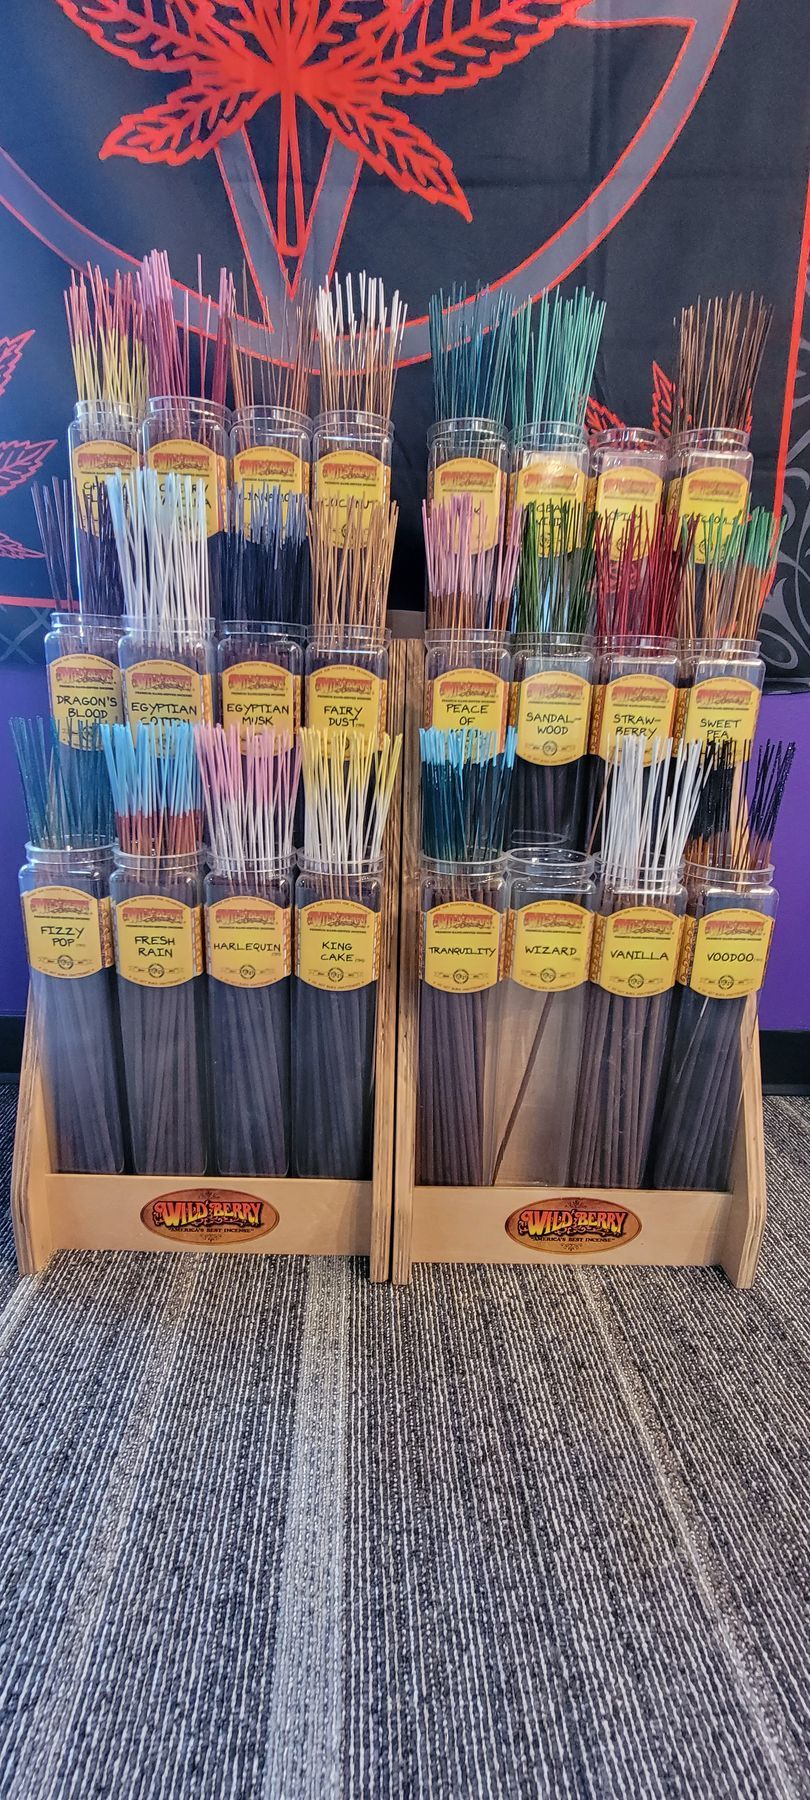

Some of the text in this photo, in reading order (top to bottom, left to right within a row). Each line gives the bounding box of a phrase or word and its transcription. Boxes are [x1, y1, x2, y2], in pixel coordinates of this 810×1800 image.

[56, 695, 117, 707] DRAGON'S
[68, 708, 108, 719] BLOOD
[131, 702, 197, 716] EGYPTIAN
[226, 703, 289, 715] EGYPTIAN
[324, 706, 363, 719] FAIRY
[446, 703, 489, 714] PEACE
[242, 716, 274, 726] MUSK
[329, 717, 358, 728] DUST
[459, 716, 475, 725] OF
[613, 714, 661, 725] STRAW-
[700, 718, 741, 729] SWEET
[537, 725, 569, 736] WOOD
[40, 926, 85, 939] FIZZY
[52, 938, 75, 947] POP
[134, 935, 176, 946] FRESH
[322, 941, 353, 951] KING
[138, 947, 173, 958] RAIN
[213, 942, 281, 953] HARLEQUIN
[429, 946, 497, 958] TRANQUILITY
[525, 945, 577, 956] WIZARD
[320, 953, 354, 962] CAKE
[610, 950, 669, 961] VANILLA
[707, 952, 754, 962] VOODOO
[153, 1200, 264, 1228] WILD BERRY
[518, 1209, 628, 1237] WILD BERRY
